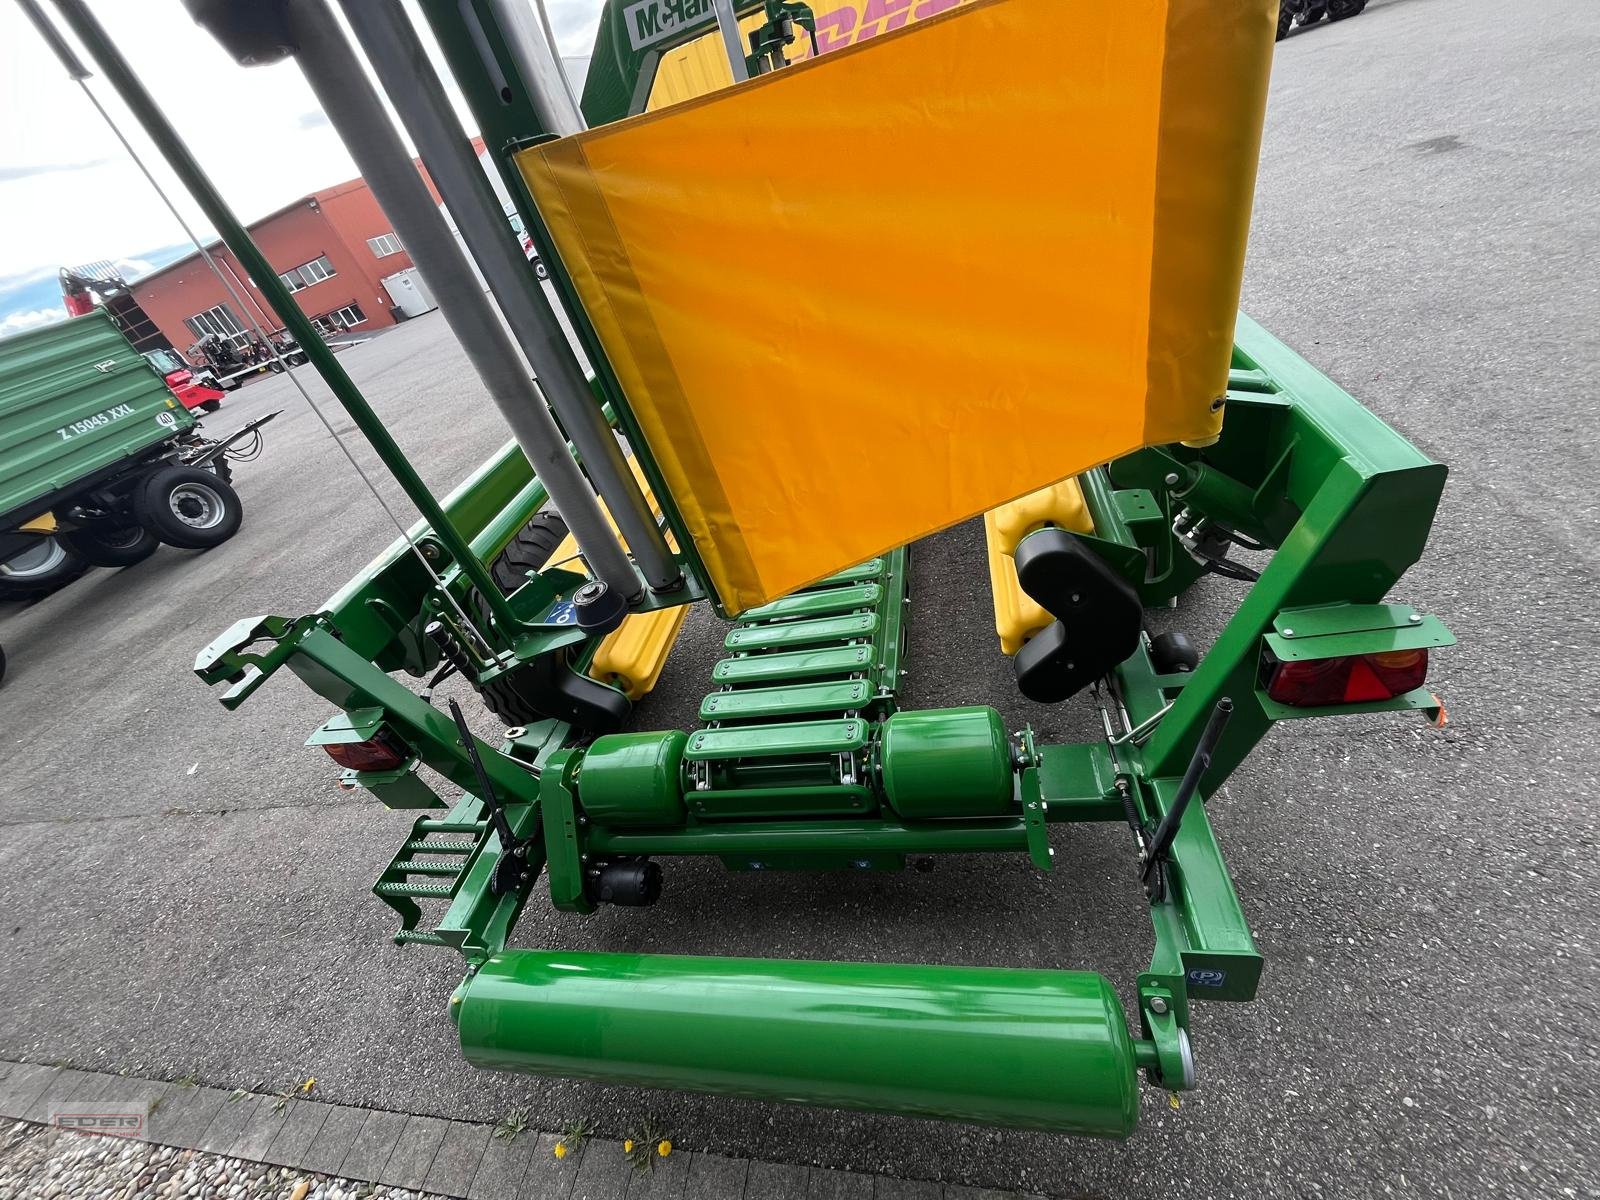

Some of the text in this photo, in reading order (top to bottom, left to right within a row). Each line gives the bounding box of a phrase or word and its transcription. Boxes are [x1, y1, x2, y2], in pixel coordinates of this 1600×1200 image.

[635, 0, 714, 41] McHa
[57, 403, 136, 441] Z 15045 XXL
[159, 413, 173, 425] 40
